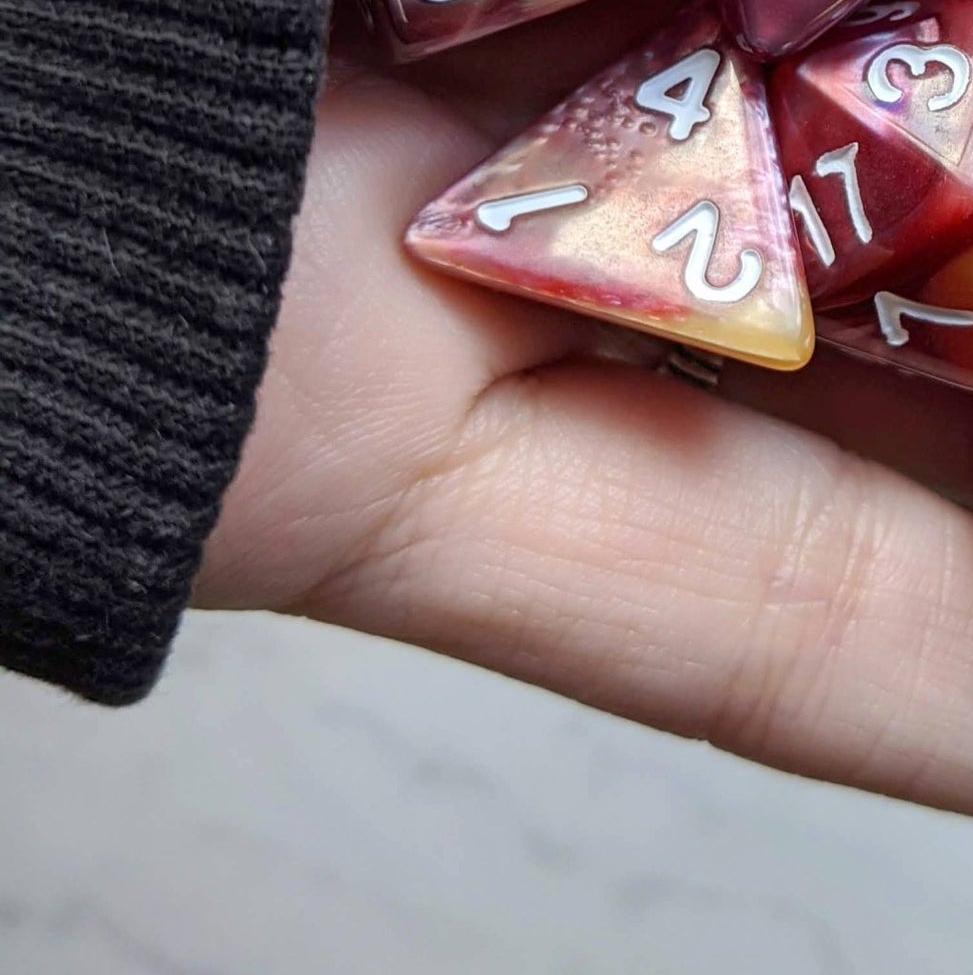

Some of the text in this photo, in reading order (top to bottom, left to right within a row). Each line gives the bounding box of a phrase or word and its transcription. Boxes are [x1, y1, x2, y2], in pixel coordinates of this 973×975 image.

[636, 48, 722, 141] 4
[868, 44, 970, 112] 3
[477, 185, 589, 232] 1
[652, 200, 763, 303] 2
[789, 142, 873, 268] 17
